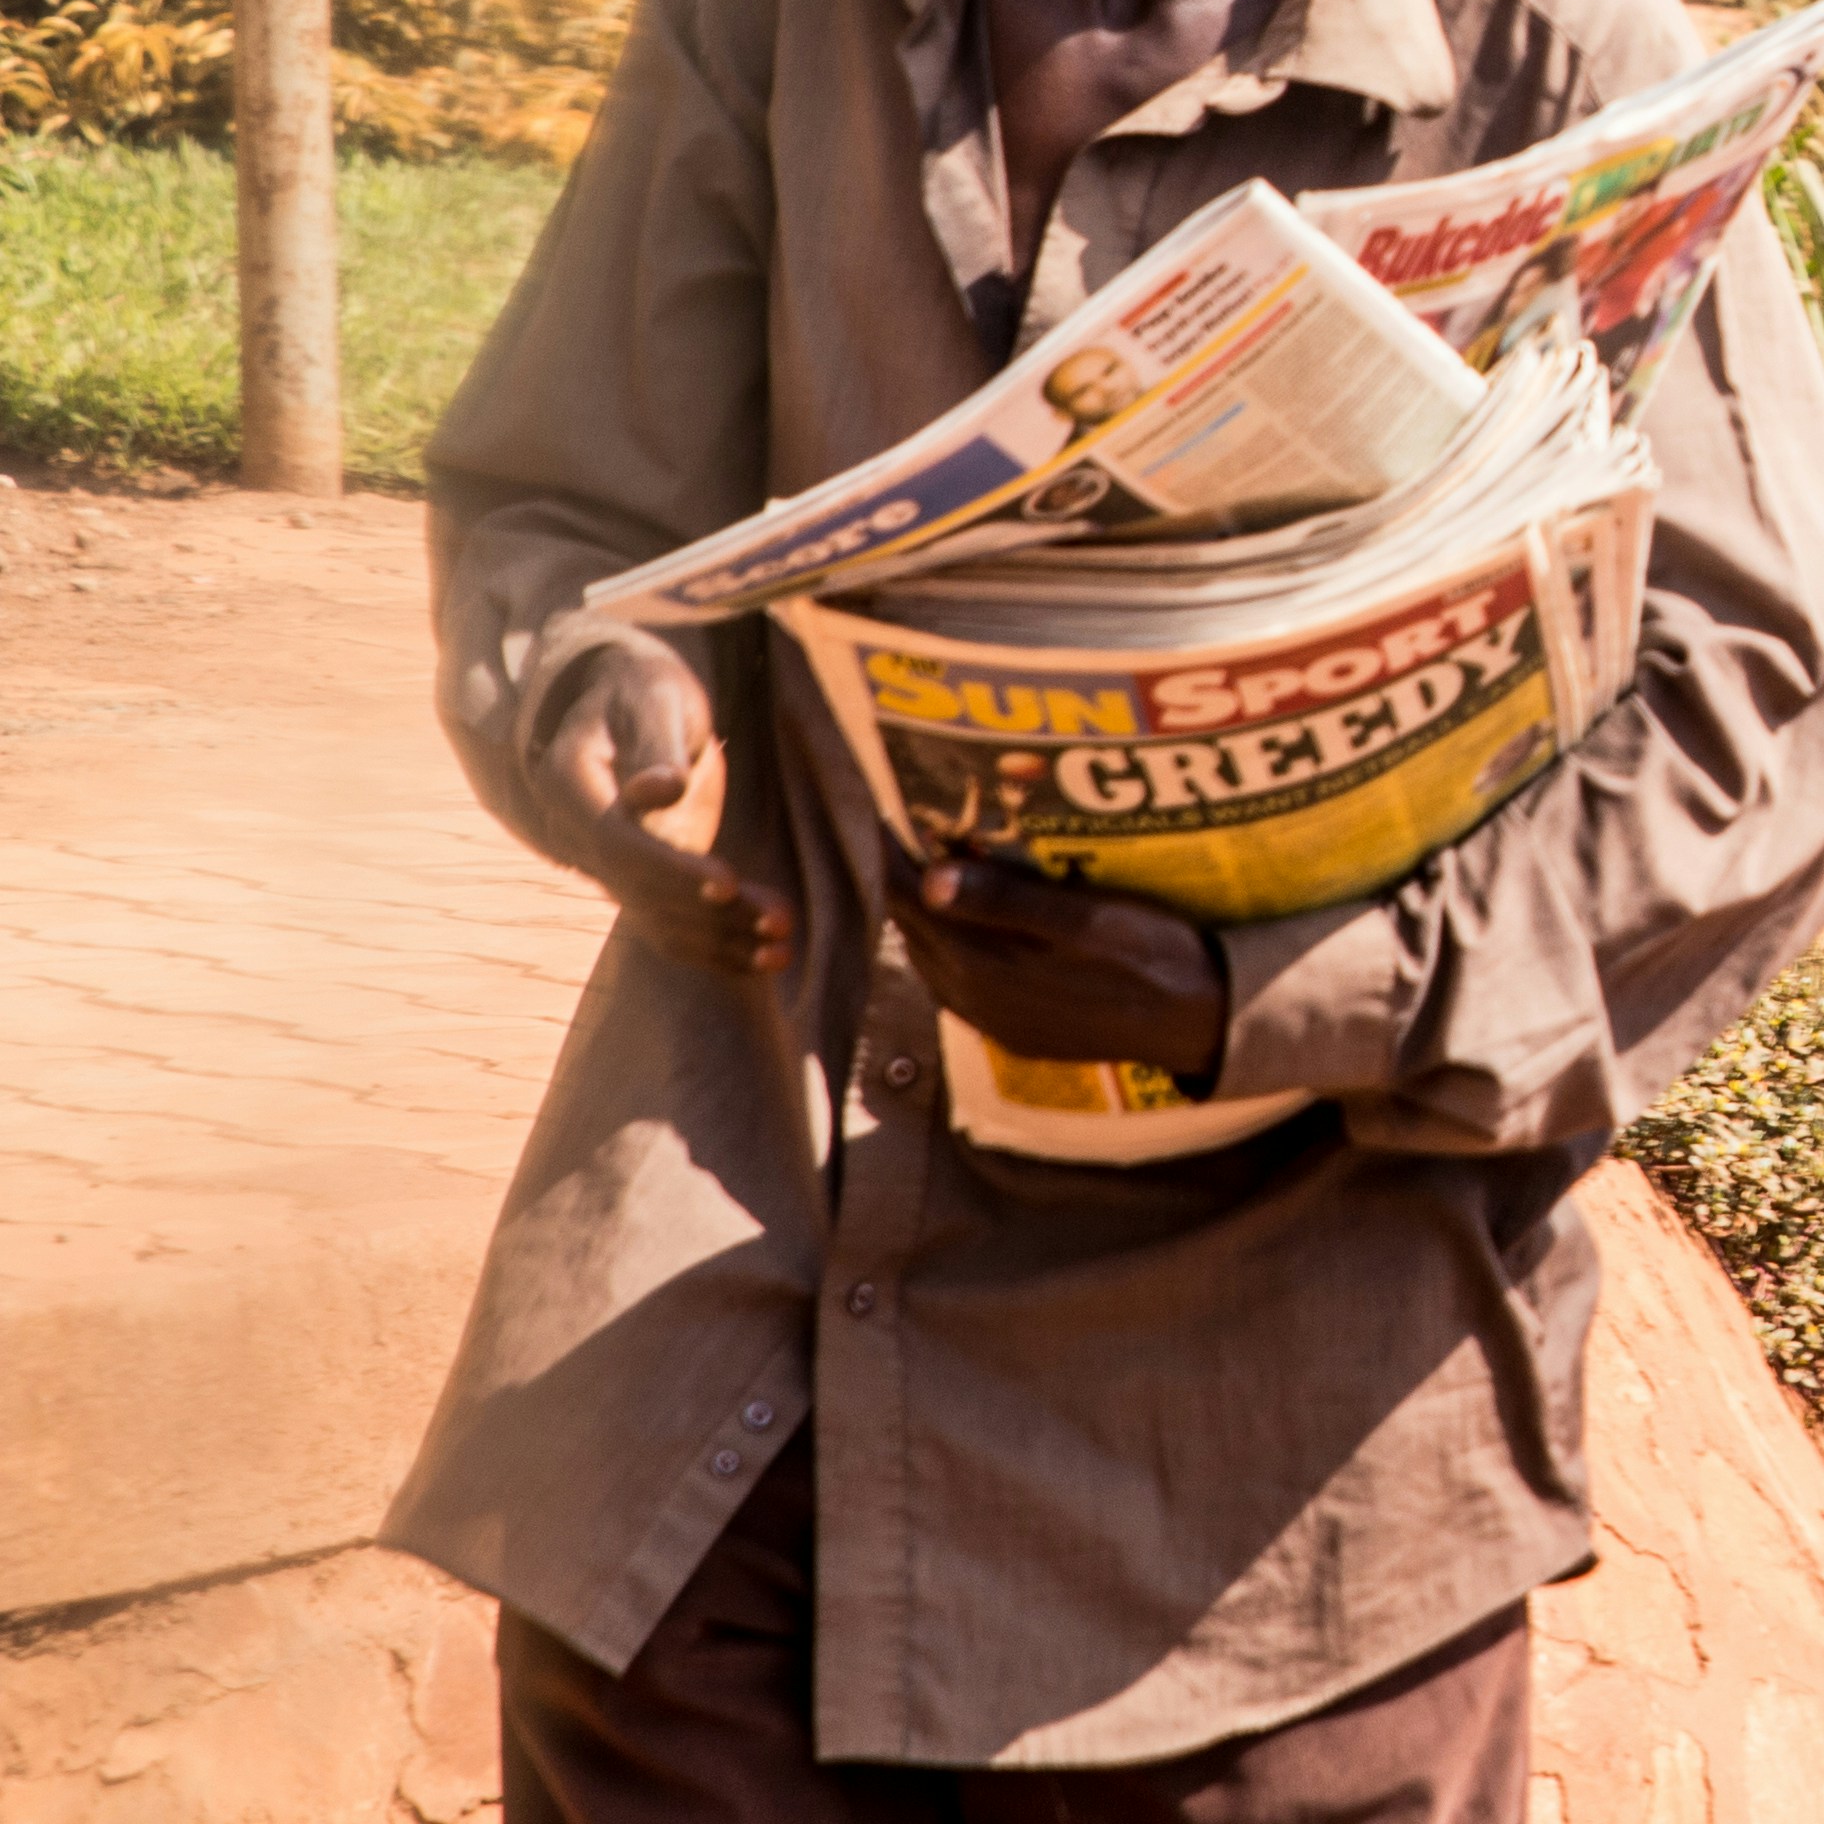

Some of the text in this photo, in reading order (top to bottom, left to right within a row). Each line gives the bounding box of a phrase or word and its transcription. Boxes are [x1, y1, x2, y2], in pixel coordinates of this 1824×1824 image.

[866, 589, 1498, 735] SUN SPORT
[1054, 604, 1530, 814] GREEDY
